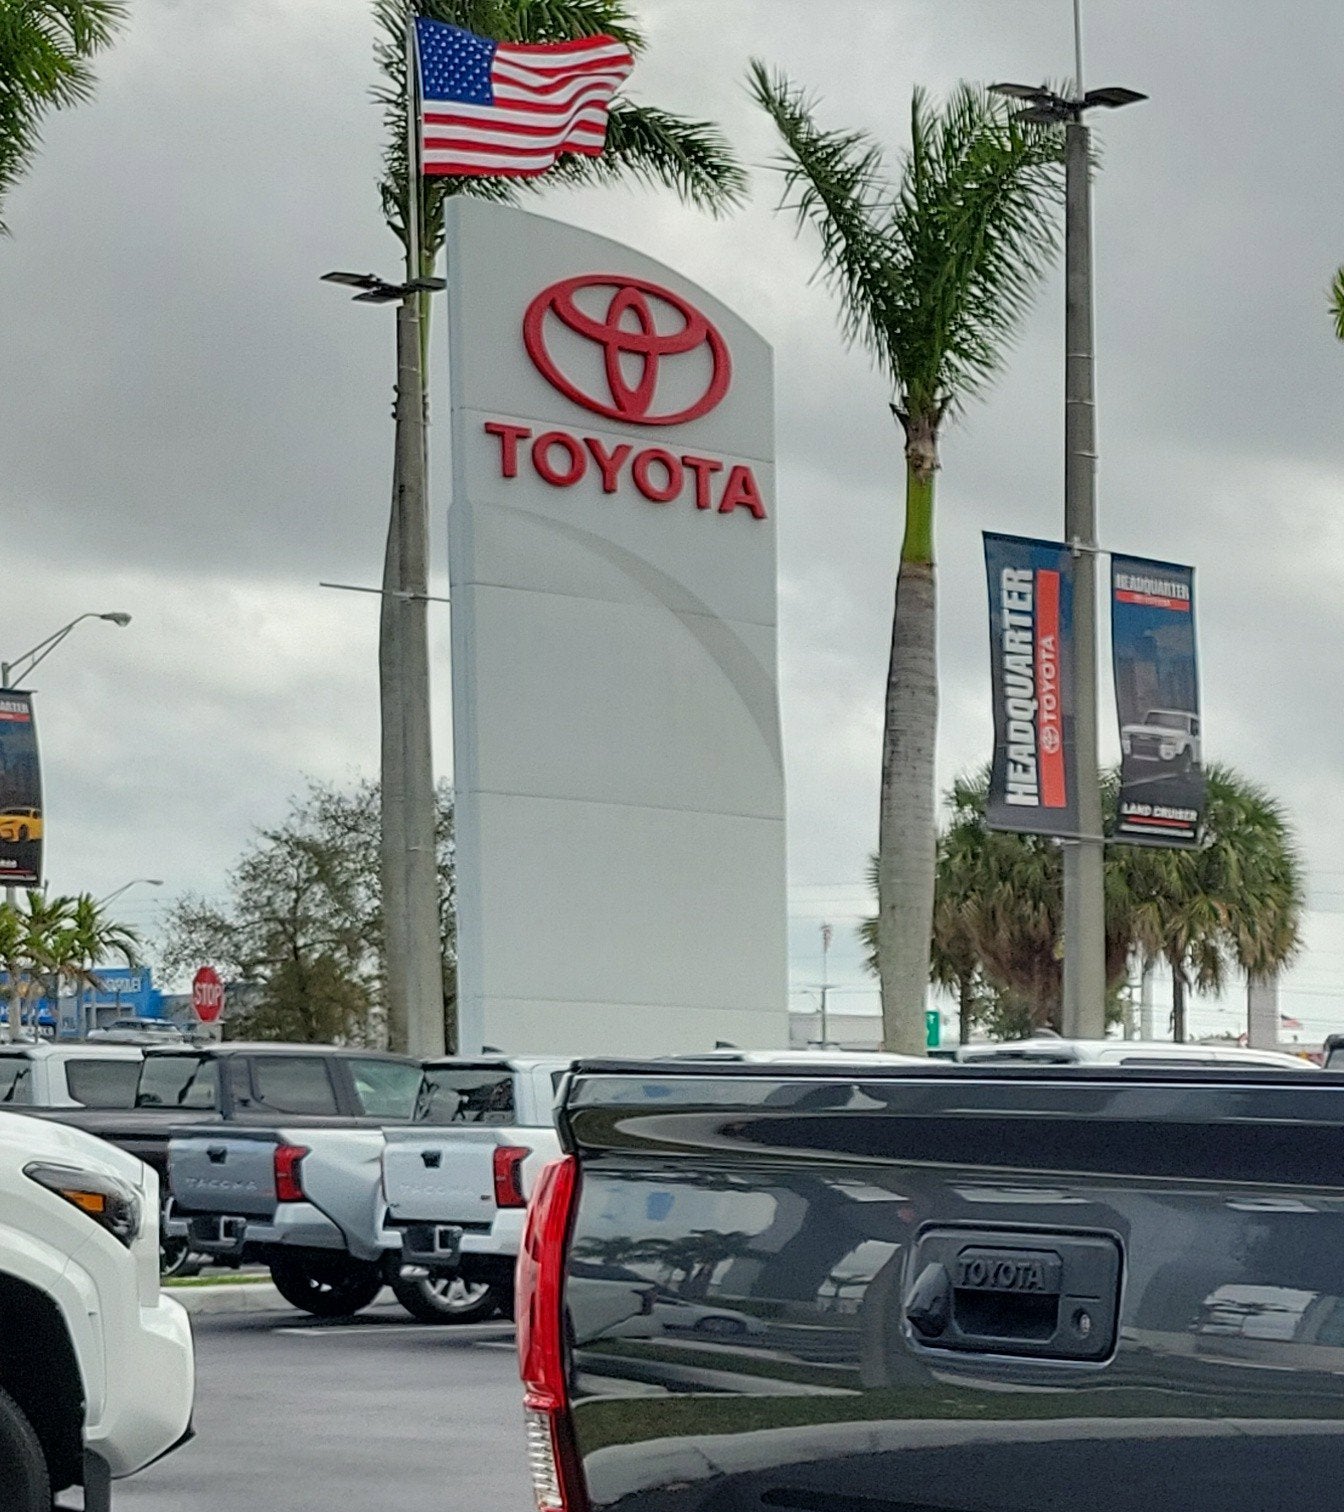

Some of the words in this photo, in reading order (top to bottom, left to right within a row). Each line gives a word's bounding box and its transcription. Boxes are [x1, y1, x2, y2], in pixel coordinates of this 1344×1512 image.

[484, 422, 767, 519] TOYOTA
[1002, 567, 1039, 806] HEADQUARTER
[1039, 634, 1057, 723] TOYOTA
[195, 984, 222, 1006] STOP
[959, 1257, 1046, 1291] TOYOTA
